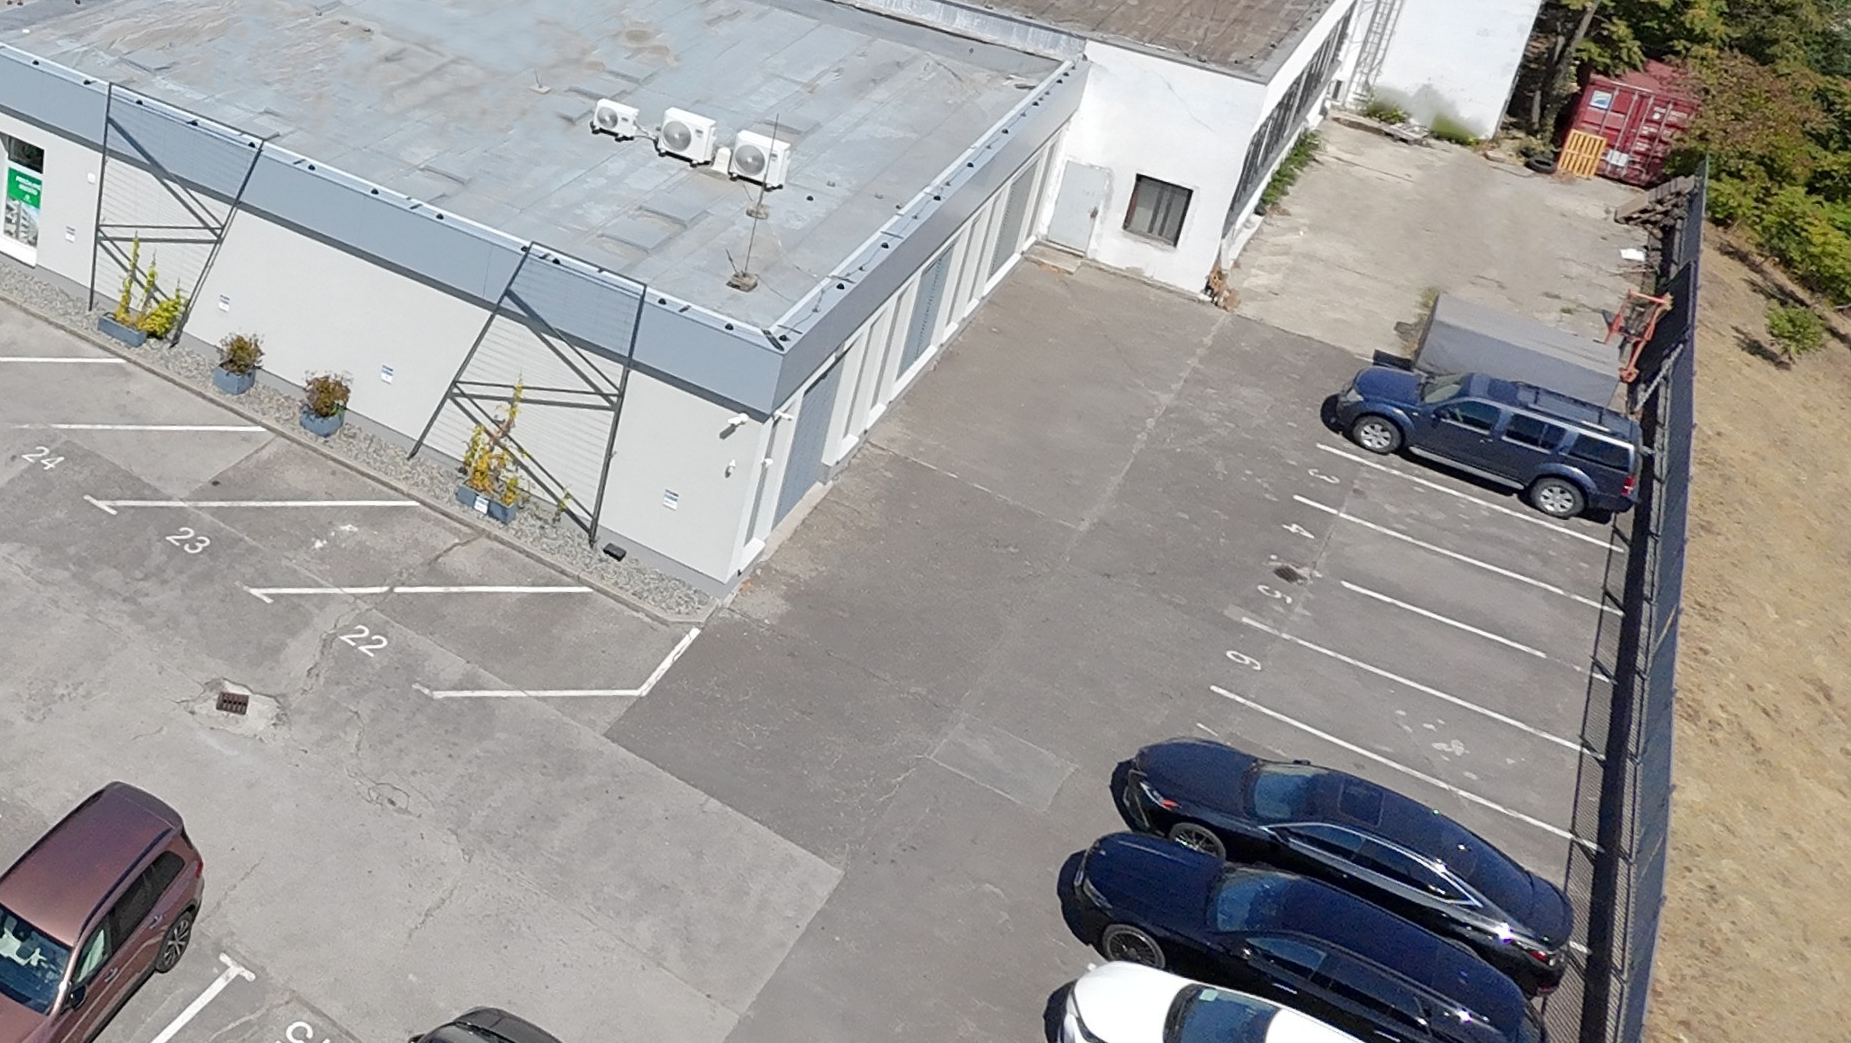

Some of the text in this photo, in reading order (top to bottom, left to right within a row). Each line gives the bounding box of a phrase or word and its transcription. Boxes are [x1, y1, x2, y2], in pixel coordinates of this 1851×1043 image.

[21, 446, 65, 470] 24
[1308, 468, 1340, 484] 3
[165, 527, 211, 554] 23
[1282, 523, 1315, 539] 4
[1257, 584, 1293, 604] 5
[339, 624, 388, 657] 22
